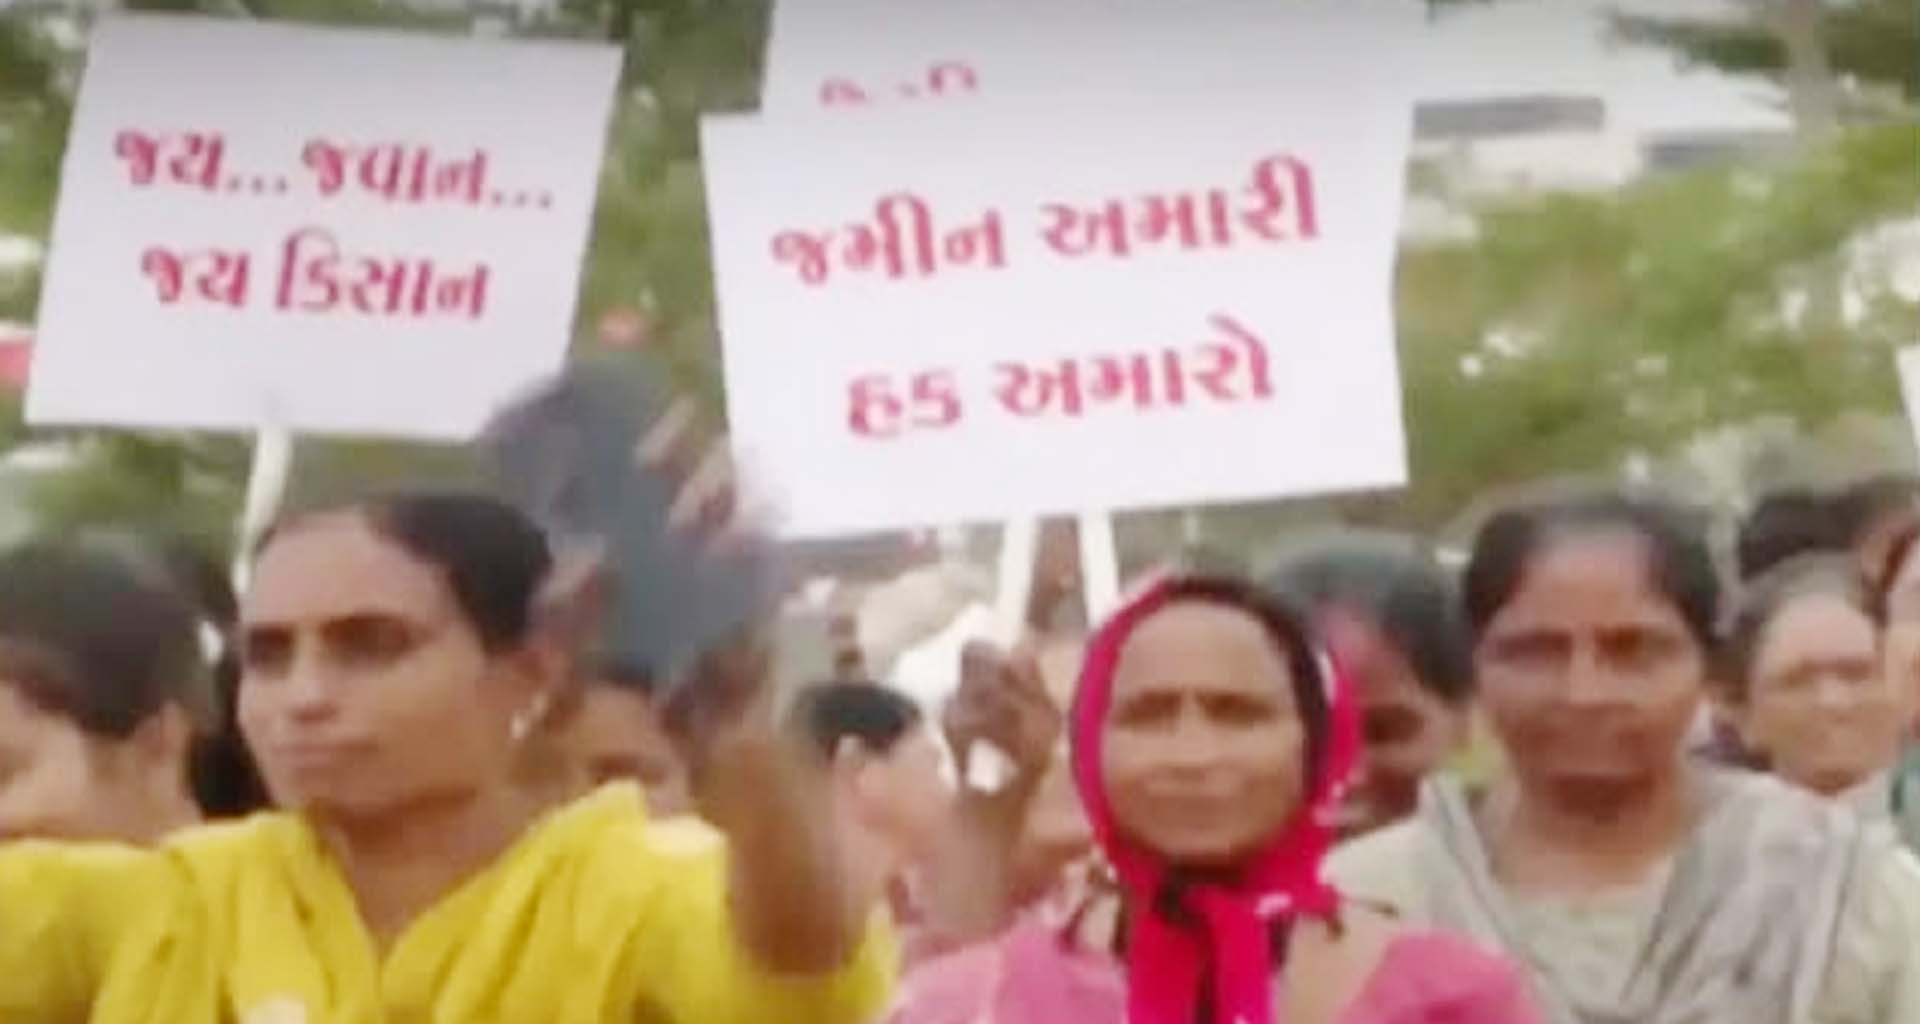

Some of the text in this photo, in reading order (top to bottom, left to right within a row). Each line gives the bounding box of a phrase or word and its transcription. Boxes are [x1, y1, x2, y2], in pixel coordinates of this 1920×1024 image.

[140, 226, 489, 319] જય કિસાન
[769, 152, 1319, 286] જમીન અમારી
[847, 312, 1273, 437] હક અમારો
